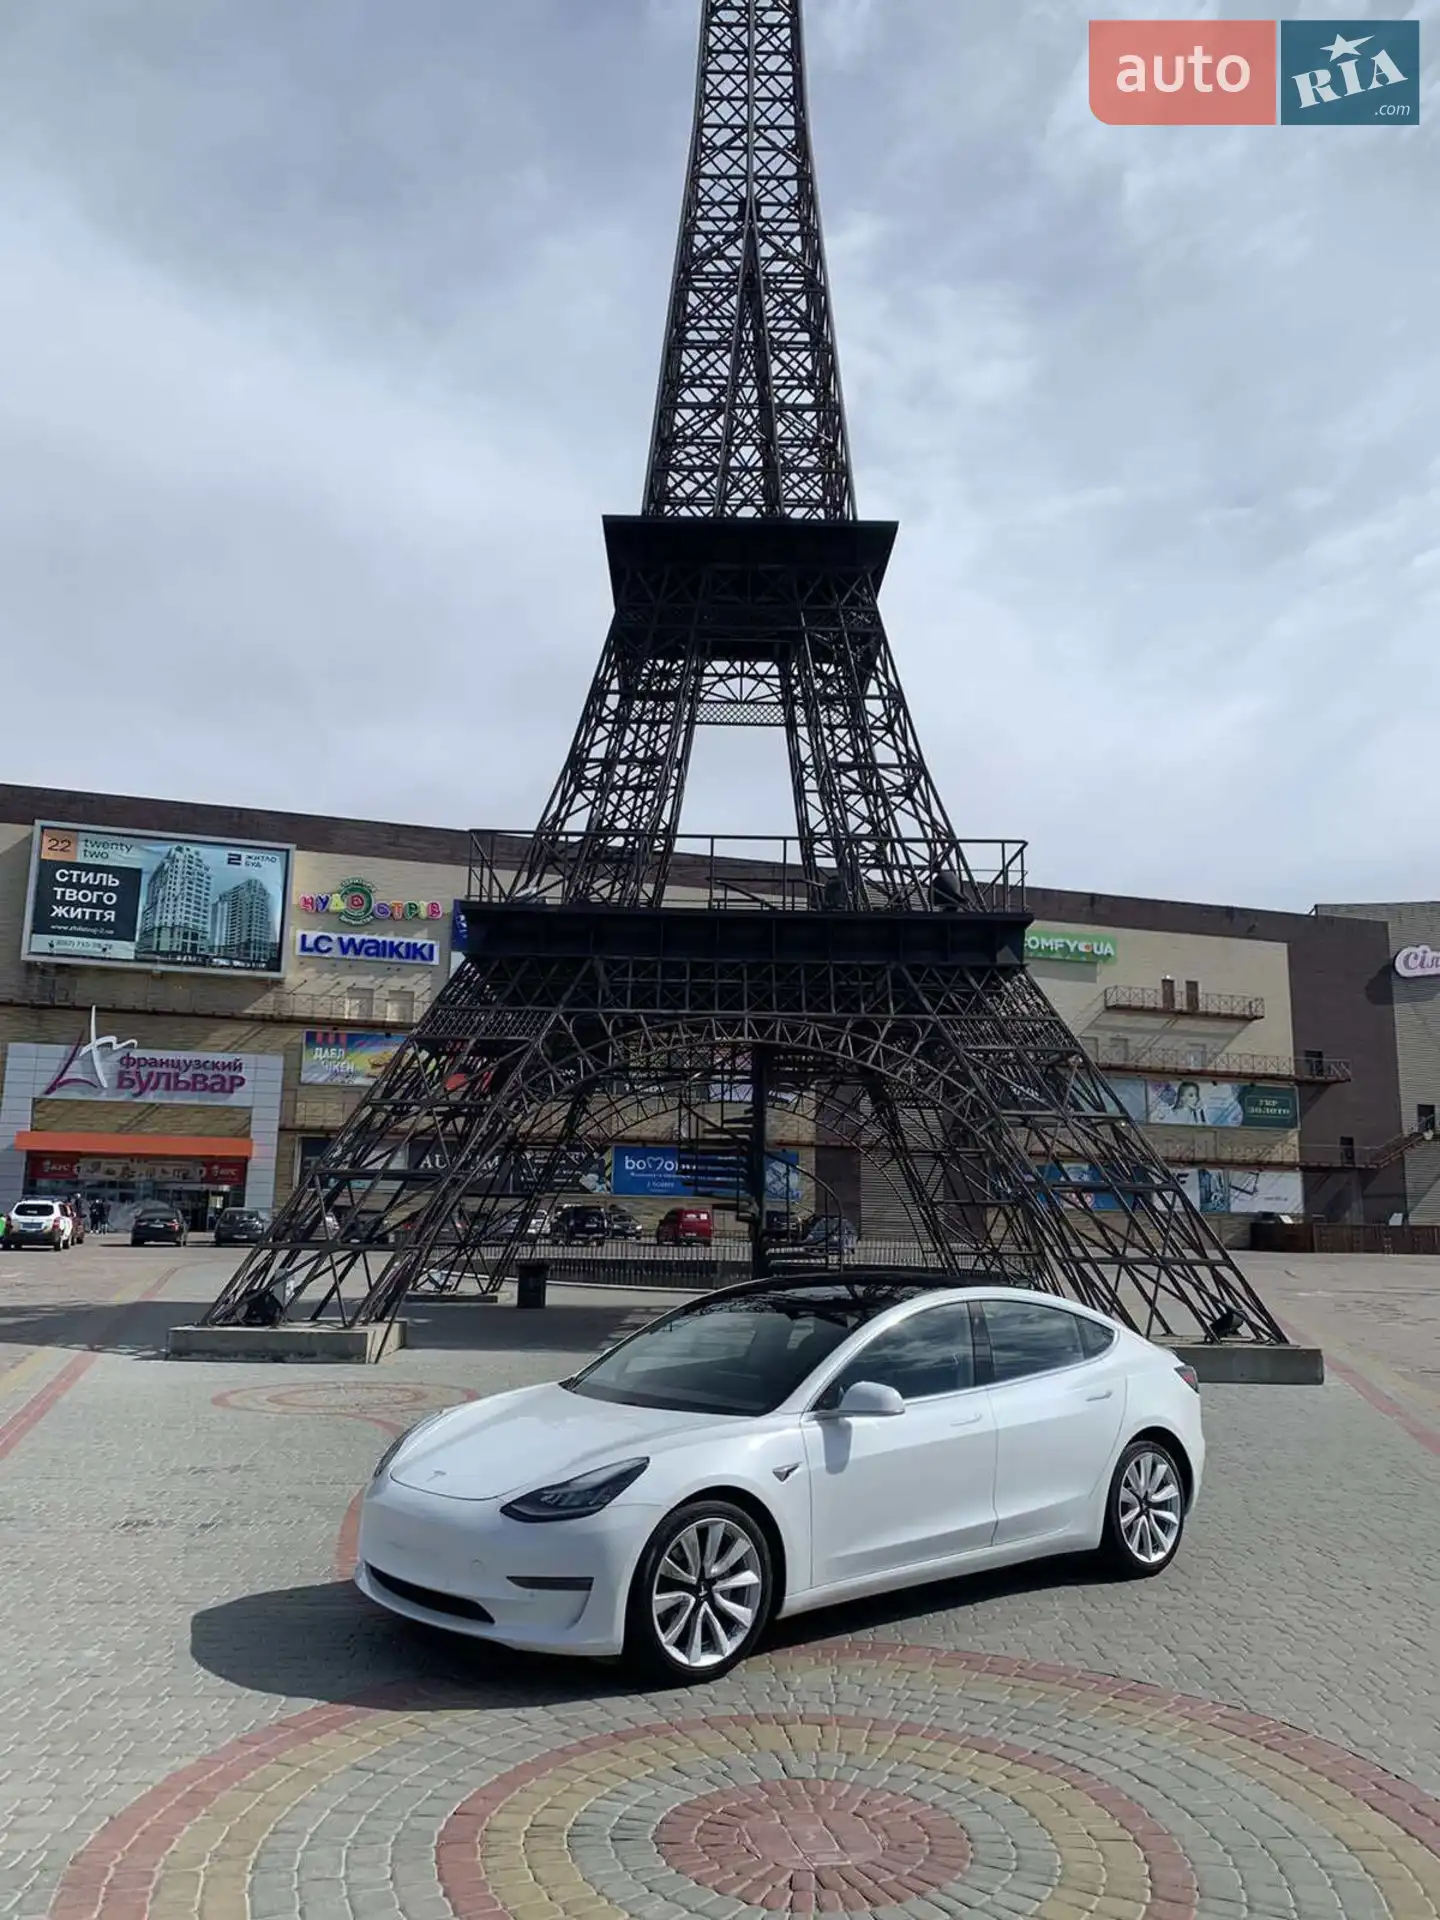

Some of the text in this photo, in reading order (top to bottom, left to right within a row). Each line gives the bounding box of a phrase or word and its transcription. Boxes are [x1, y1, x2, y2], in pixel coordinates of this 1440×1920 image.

[47, 838, 72, 853] 22
[84, 839, 133, 853] twenty
[83, 849, 109, 860] two
[55, 868, 120, 887] СТИЛЬ
[53, 887, 118, 905] ТВОГО
[50, 905, 116, 922] ЖИТТЯ
[301, 934, 332, 954] LC
[120, 1052, 243, 1072] французский
